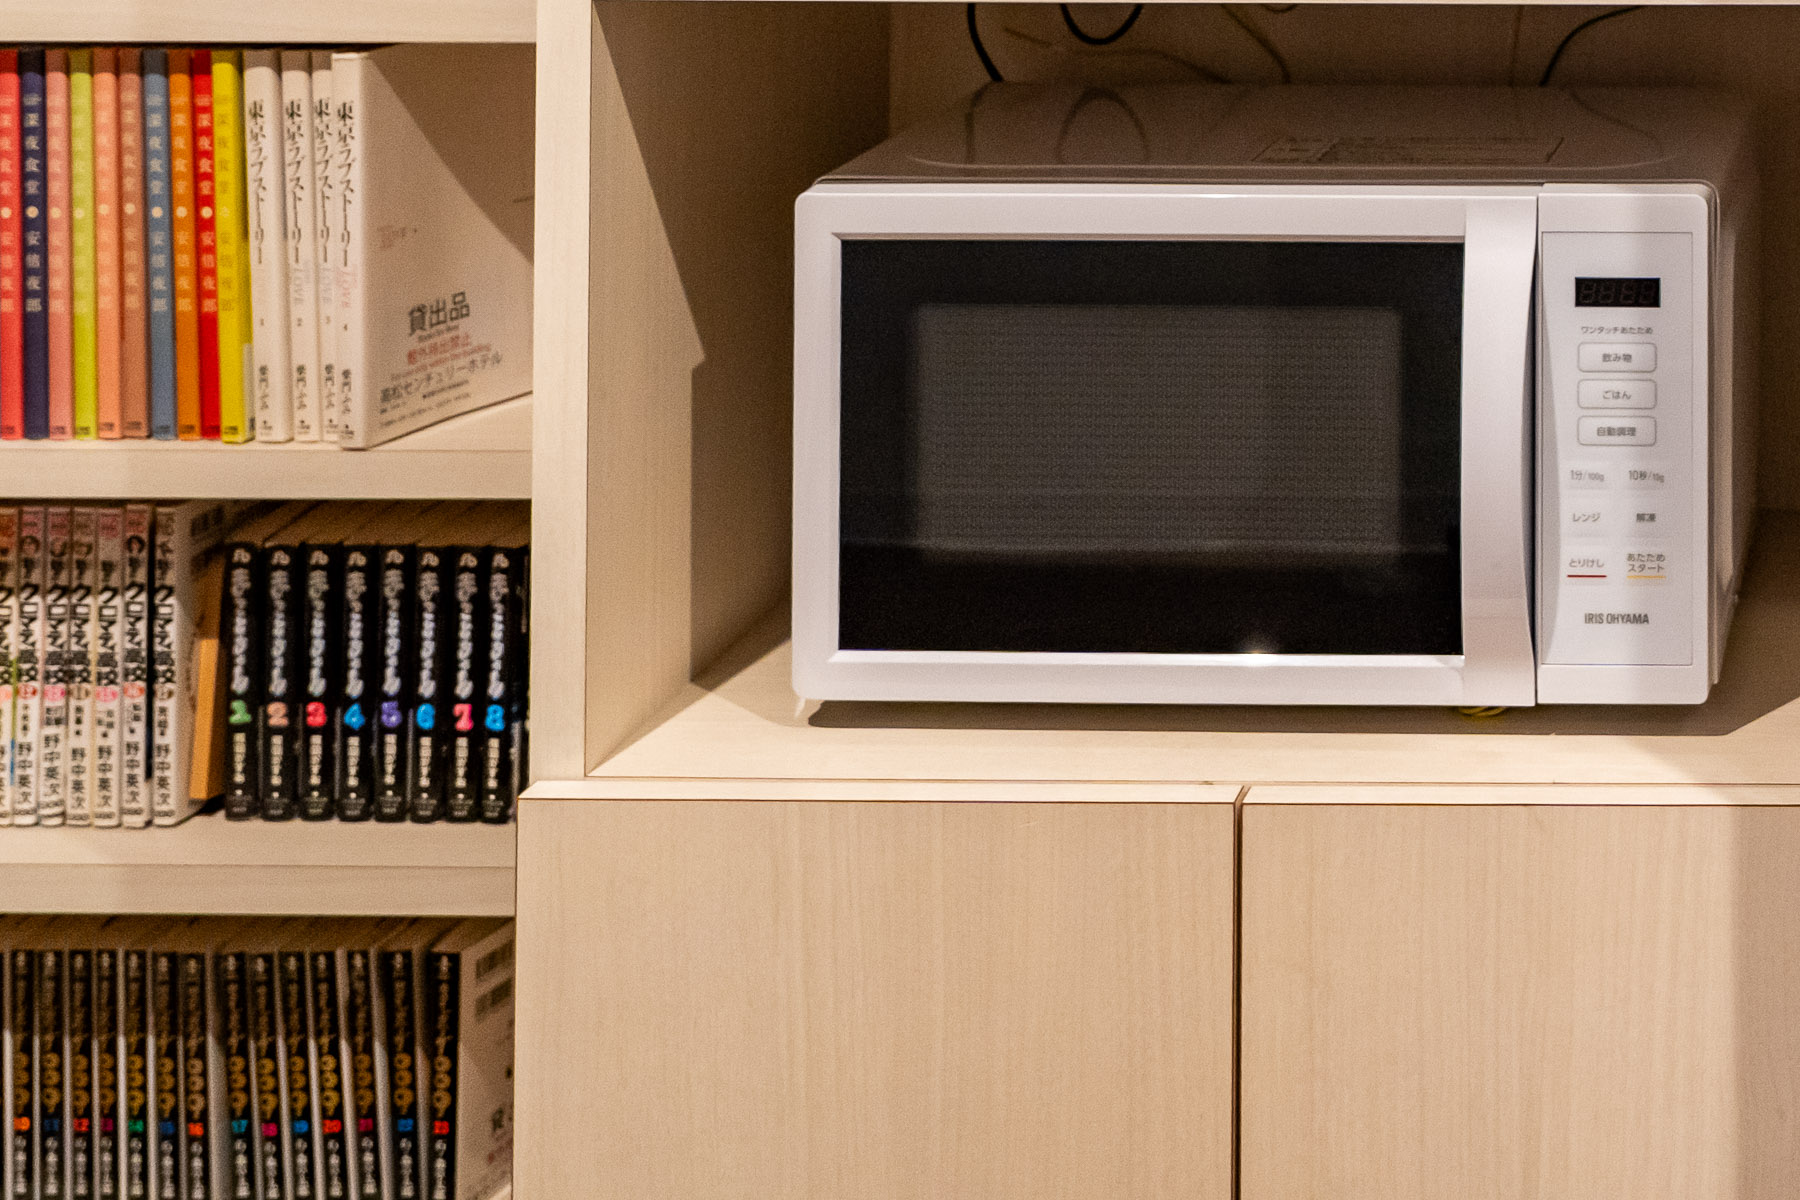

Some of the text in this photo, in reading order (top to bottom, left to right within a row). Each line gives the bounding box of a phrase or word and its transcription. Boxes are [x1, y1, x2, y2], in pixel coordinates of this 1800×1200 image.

[1602, 353, 1632, 363] 飲み物
[1602, 390, 1632, 400] ごはん
[1572, 513, 1601, 523] レンジ
[1568, 558, 1605, 568] とりけし
[1626, 553, 1666, 563] あたため
[1628, 563, 1665, 573] スタート
[1584, 612, 1650, 624] IRIS OHYAMA
